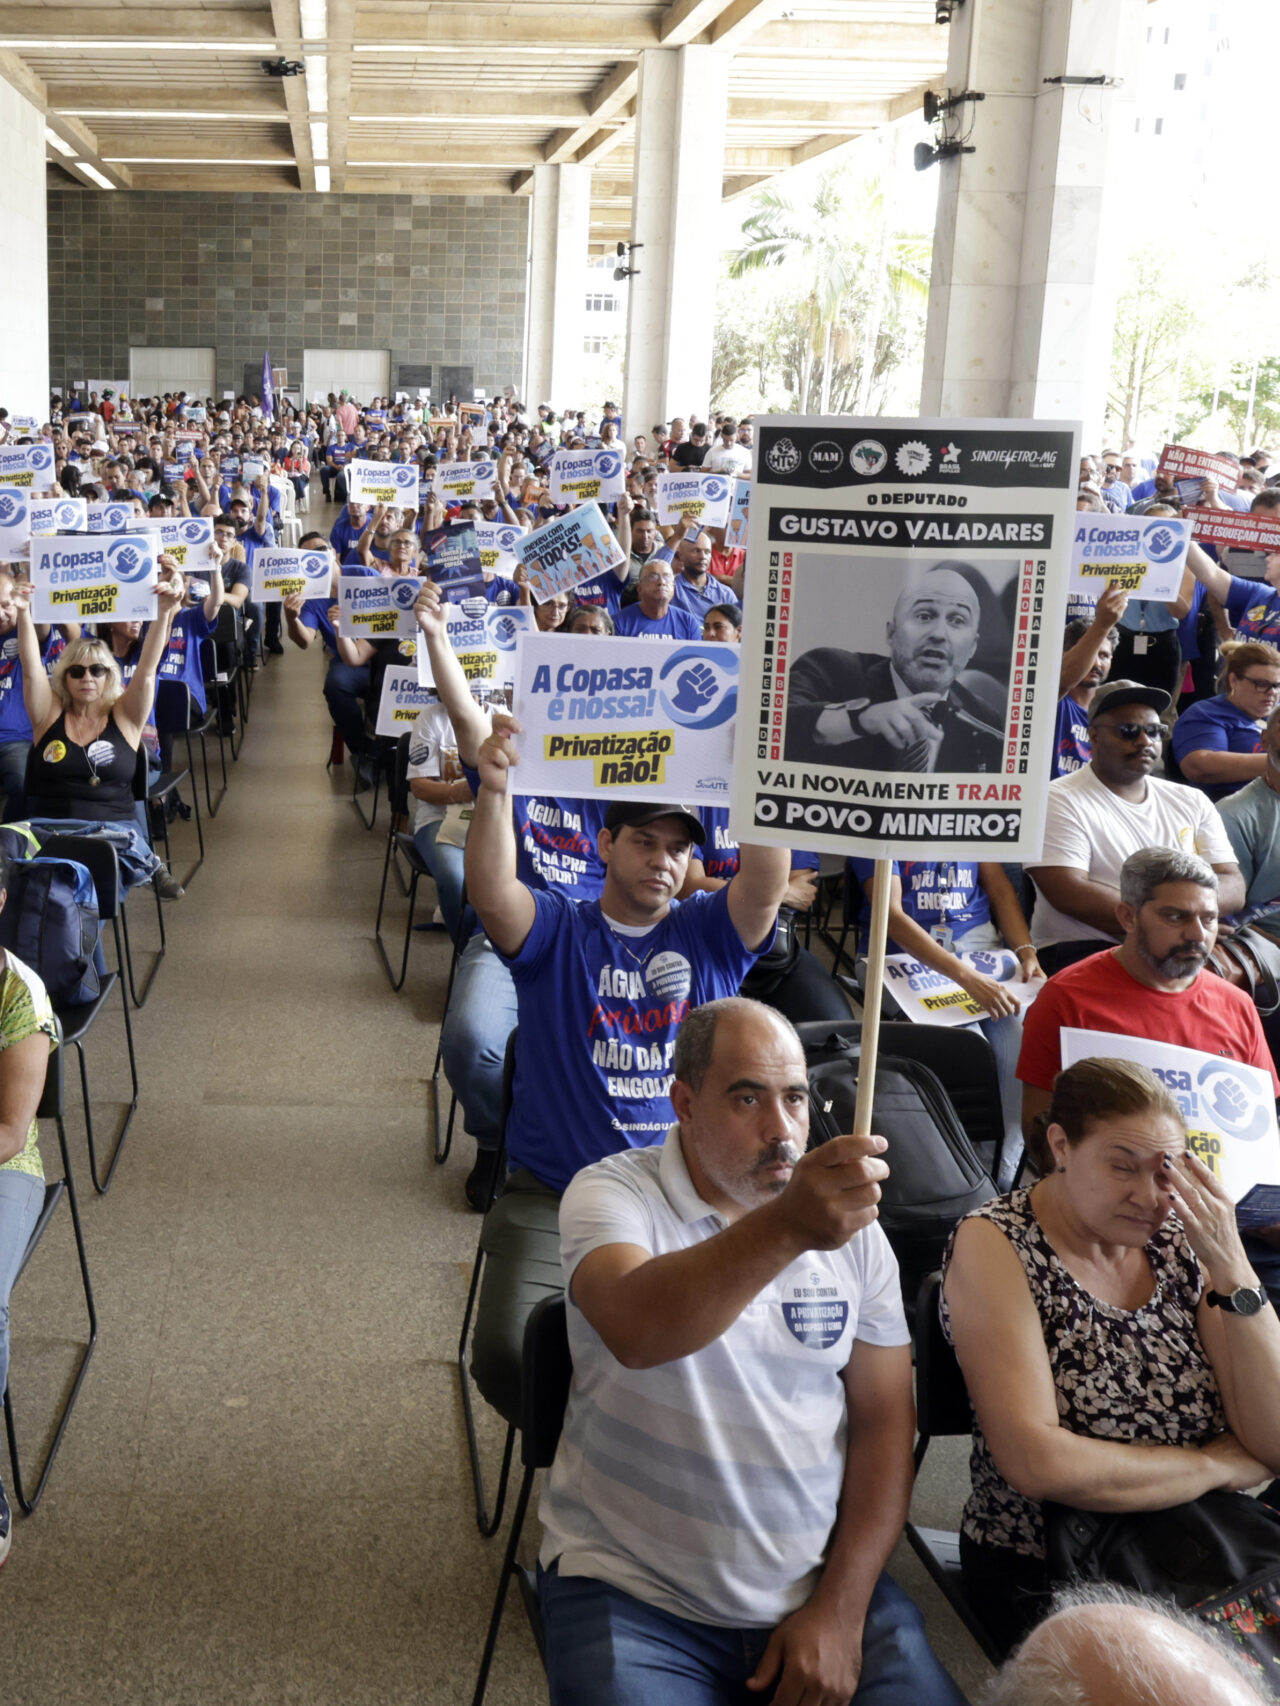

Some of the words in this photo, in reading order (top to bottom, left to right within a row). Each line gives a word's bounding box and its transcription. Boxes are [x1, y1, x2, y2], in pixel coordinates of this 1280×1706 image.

[1167, 449, 1185, 462] NÃO
[1185, 454, 1197, 464] AO
[1163, 461, 1178, 471] SIM
[867, 494, 878, 505] O
[881, 493, 968, 507] DEPUTADO
[779, 515, 898, 539] GUSTAVO
[905, 520, 1044, 542] VALADARES
[1075, 528, 1085, 543] A
[1088, 528, 1140, 544] Copasa
[1201, 524, 1213, 535] SE
[1213, 527, 1259, 542] ESQUEÇAM
[523, 533, 548, 554] mexeu
[548, 523, 564, 537] com
[539, 533, 564, 553] mexeu
[564, 522, 581, 537] com
[538, 533, 582, 570] TODAS!
[1082, 542, 1090, 556] é
[1093, 542, 1141, 556] nossa!
[40, 554, 50, 569] A
[53, 551, 103, 569] Copasa
[50, 569, 58, 584] é
[61, 564, 106, 582] nossa!
[1082, 564, 1146, 577] Privatização
[53, 585, 117, 602] Privatização
[345, 589, 352, 599] A
[353, 586, 389, 599] Copasa
[81, 599, 112, 615] não!
[351, 599, 357, 609] é
[359, 596, 391, 608] nossa!
[353, 612, 398, 623] Privatização
[172, 627, 183, 637] DA
[373, 621, 395, 632] não!
[169, 653, 184, 664] PRA
[531, 664, 551, 694] A
[556, 664, 653, 697] Copasa
[548, 692, 563, 721] é
[568, 689, 657, 720] nossa!
[549, 731, 671, 758] Privatização
[600, 754, 661, 785] não!
[695, 779, 729, 791] SindUTE
[758, 771, 795, 788] VAI
[802, 775, 949, 800] NOVAMENTE
[957, 784, 1022, 801] TRAIR
[527, 798, 561, 828] ÁGUA
[563, 811, 582, 832] DA
[756, 799, 778, 821] O
[786, 802, 872, 832] POVO
[879, 813, 1020, 836] MINEIRO?
[542, 851, 559, 866] DÁ
[561, 853, 587, 874] PRA
[598, 964, 647, 1000] ÁGUA
[592, 1038, 633, 1071] NÃO
[636, 1042, 663, 1071] DÁ
[794, 1288, 802, 1298] EU
[803, 1288, 815, 1297] SOU
[816, 1287, 838, 1297] CONTRA
[791, 1307, 797, 1319] A
[797, 1304, 843, 1320] PRIVATIZAÇÃO
